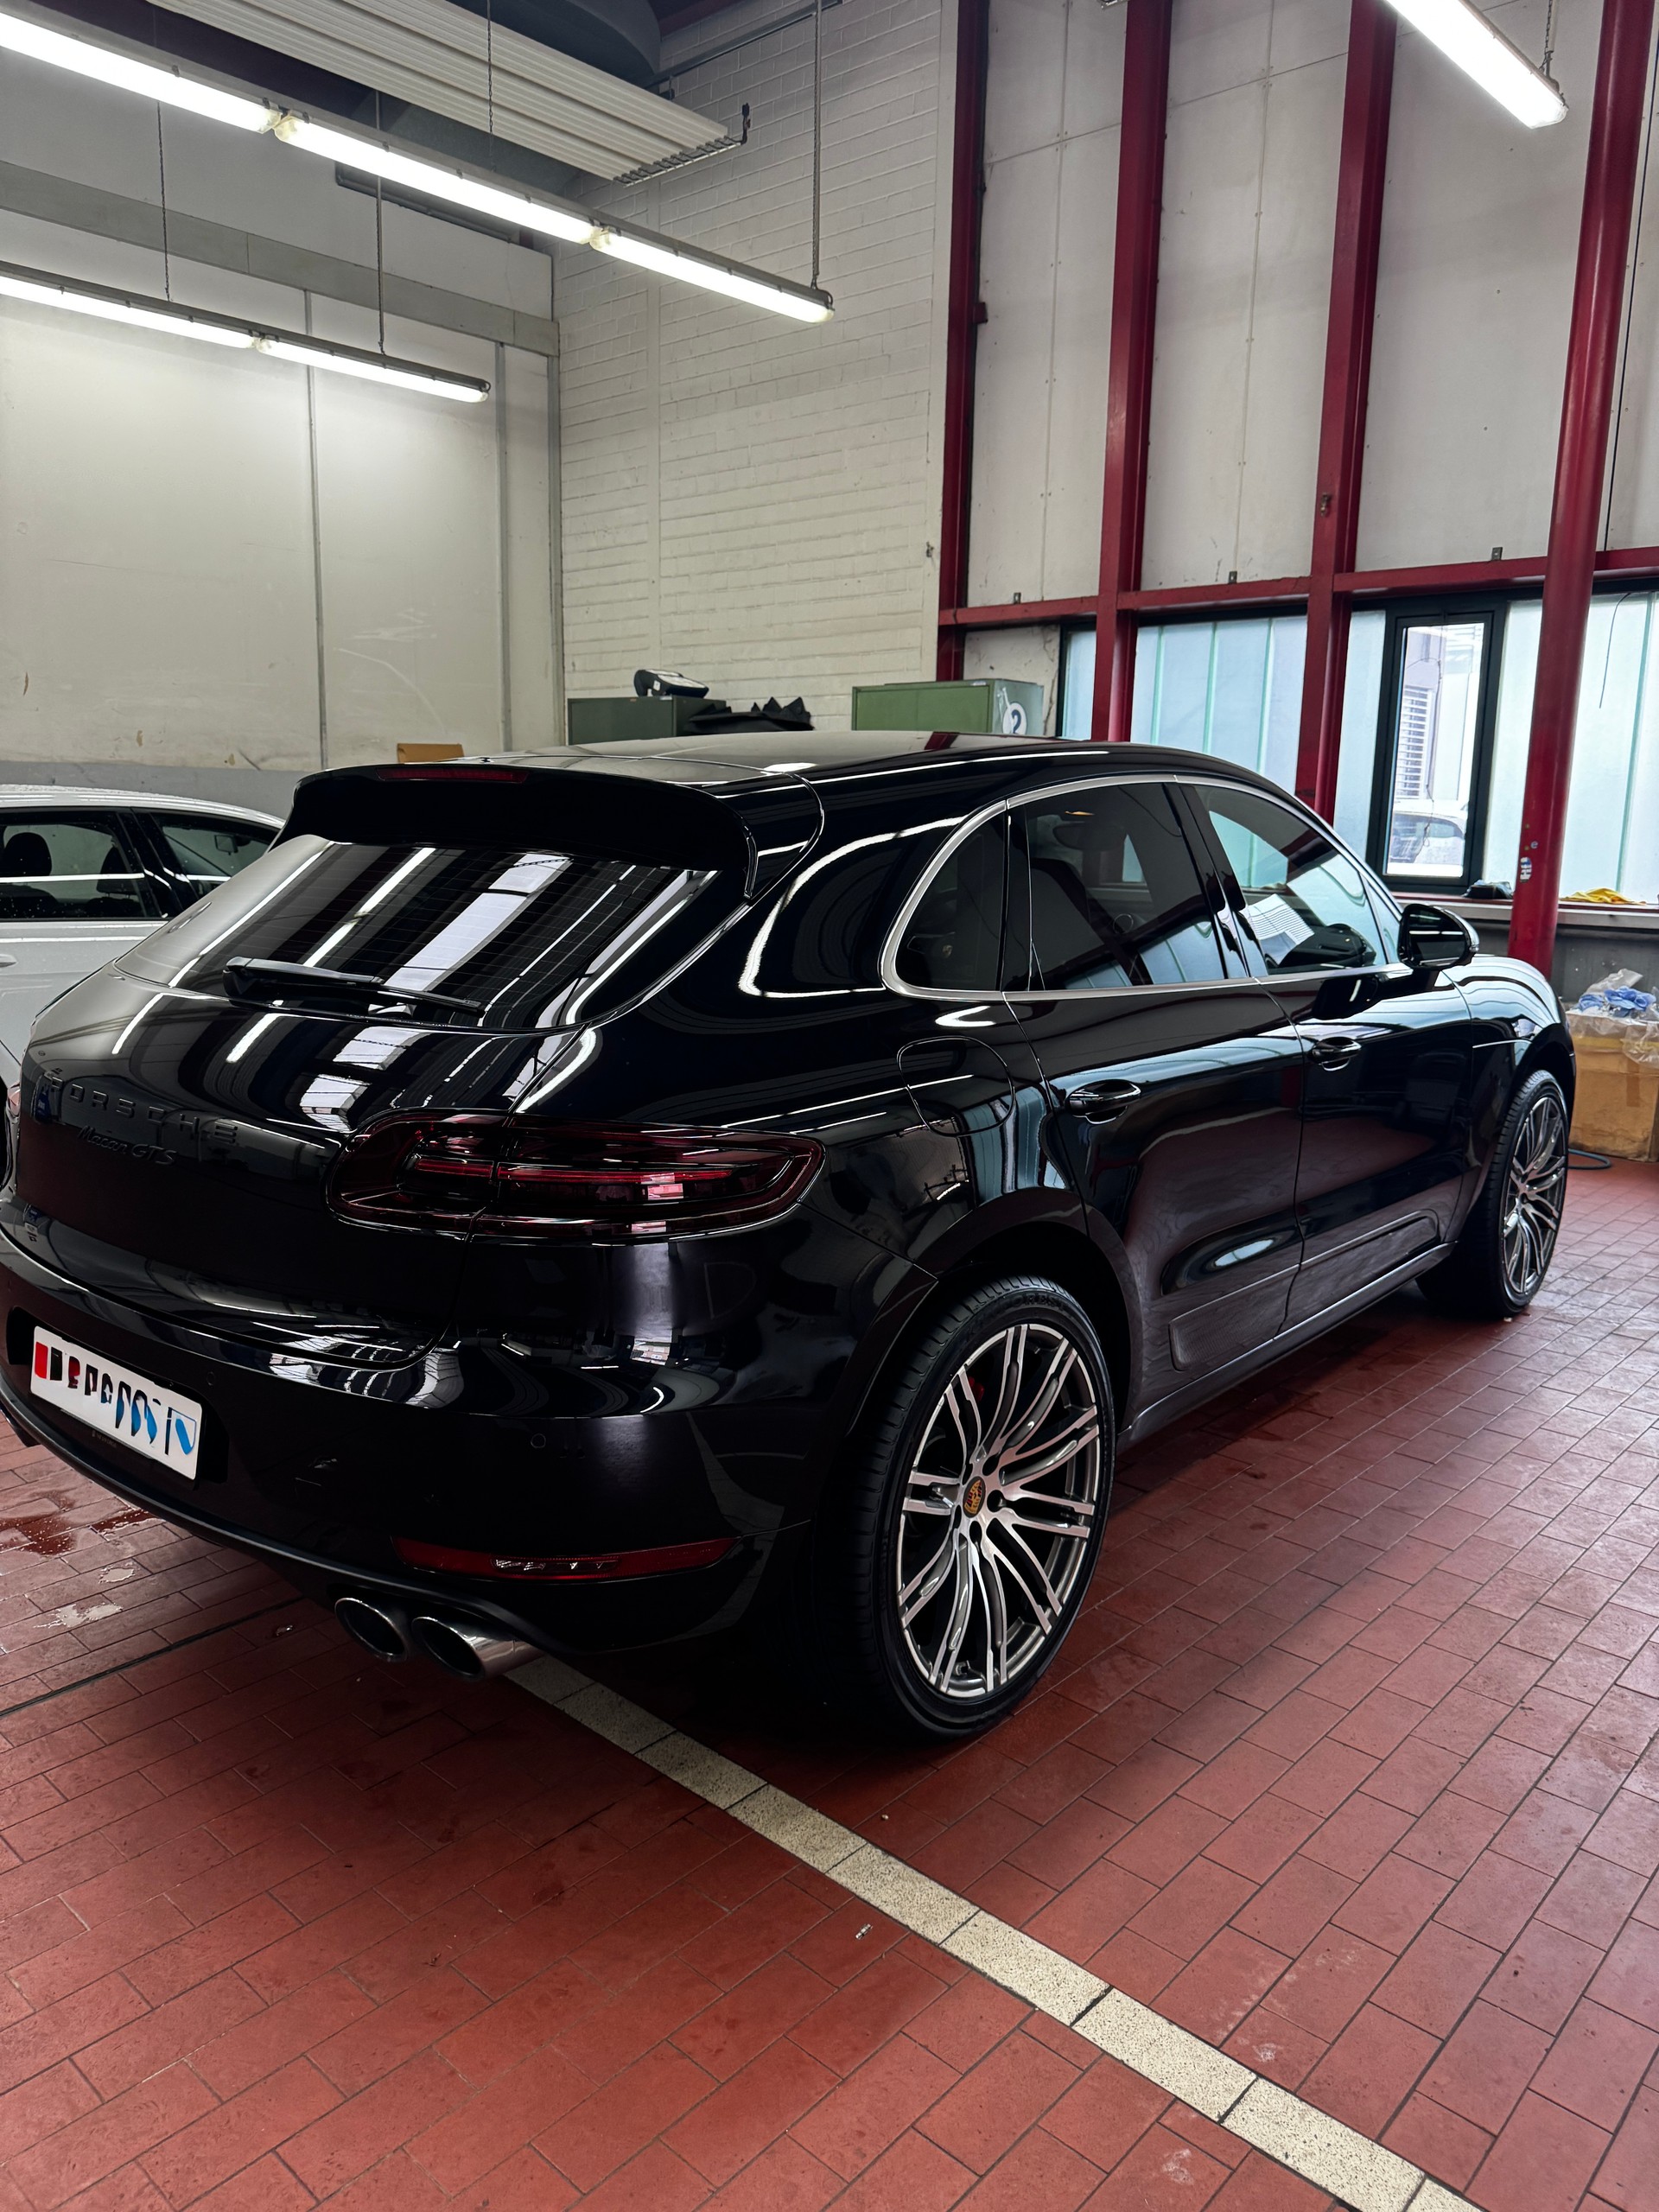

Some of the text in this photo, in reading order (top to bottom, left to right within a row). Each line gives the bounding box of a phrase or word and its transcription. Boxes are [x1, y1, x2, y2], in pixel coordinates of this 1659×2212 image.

[1011, 709, 1021, 734] 2
[50, 1076, 238, 1145] PORSCHE
[78, 1125, 177, 1166] Macan GTS
